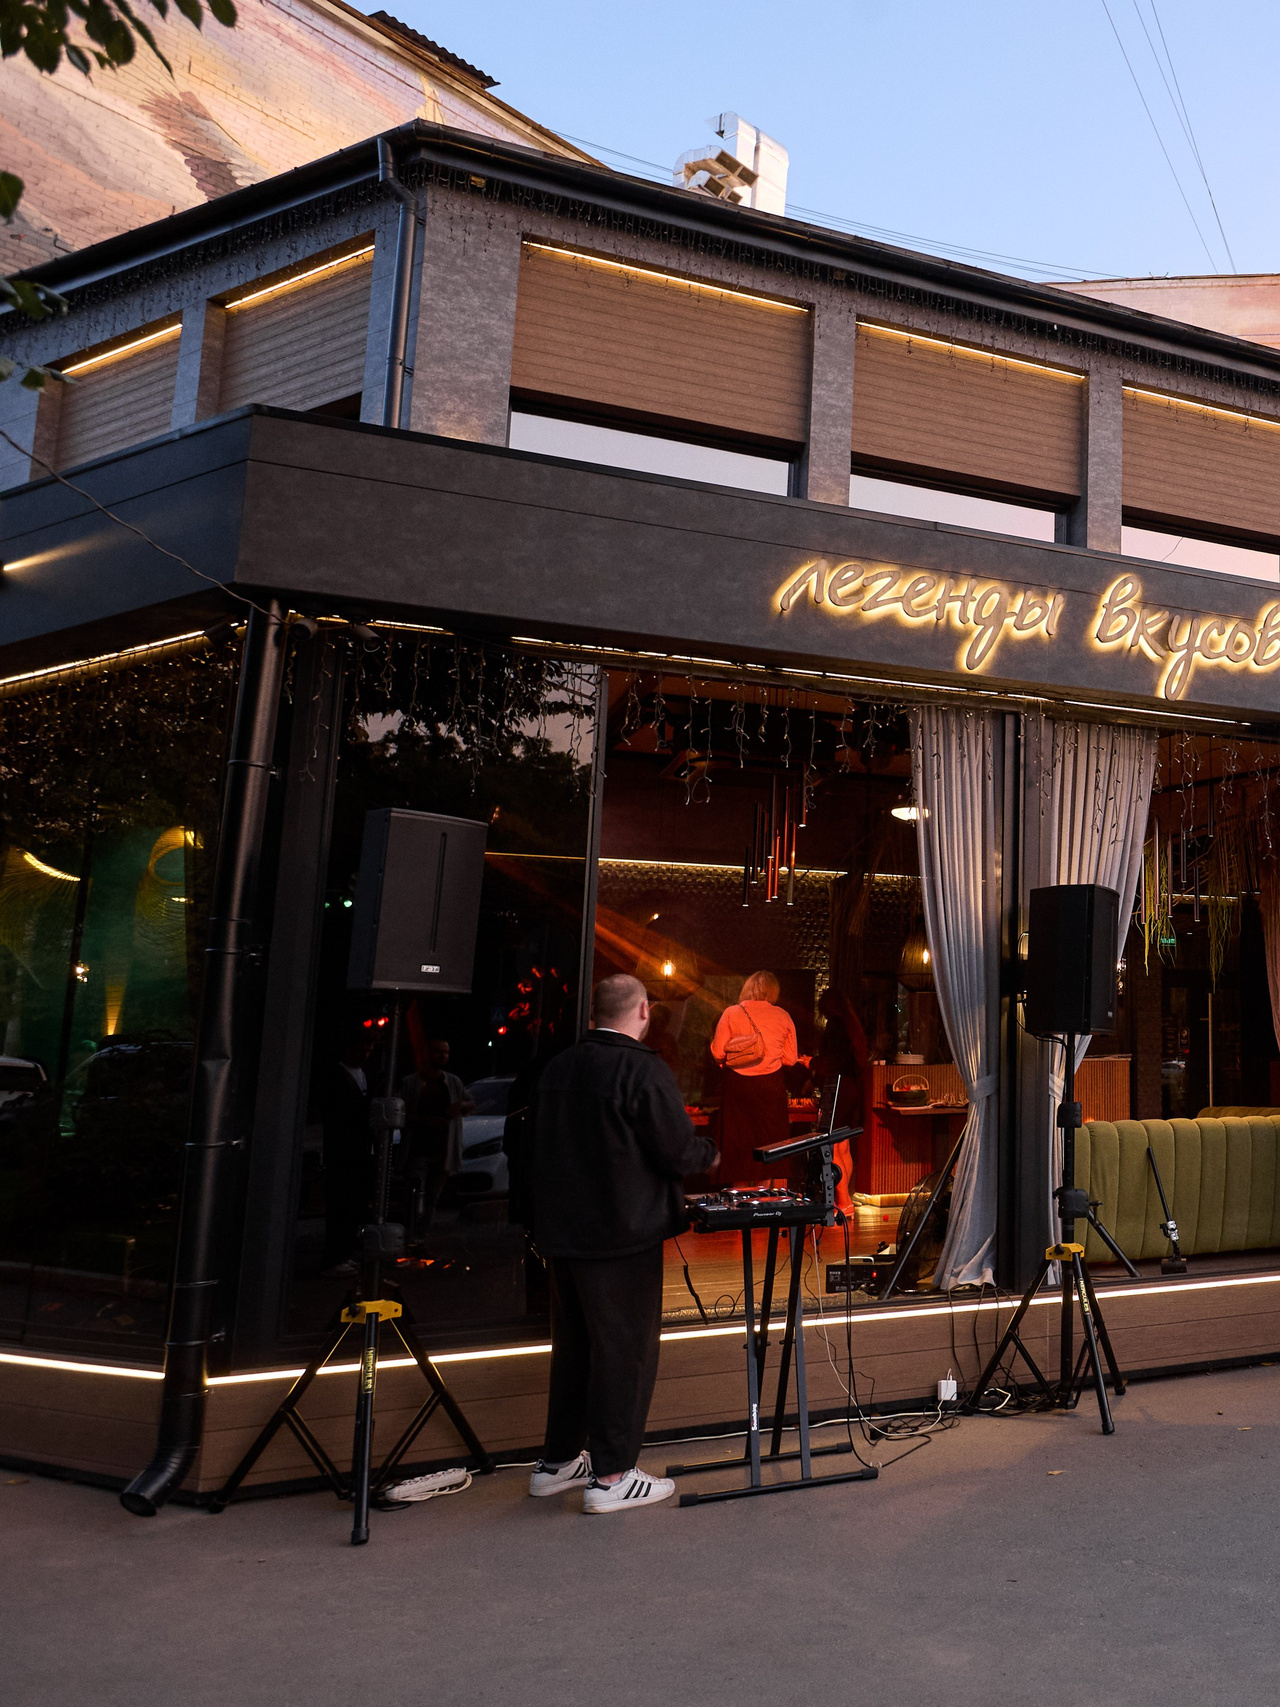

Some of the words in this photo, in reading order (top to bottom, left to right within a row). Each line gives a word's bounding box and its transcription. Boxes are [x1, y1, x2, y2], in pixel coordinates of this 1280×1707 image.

[779, 558, 1065, 670] легенды
[1079, 1280, 1090, 1312] HERCULES
[365, 1350, 374, 1390] HERCULES
